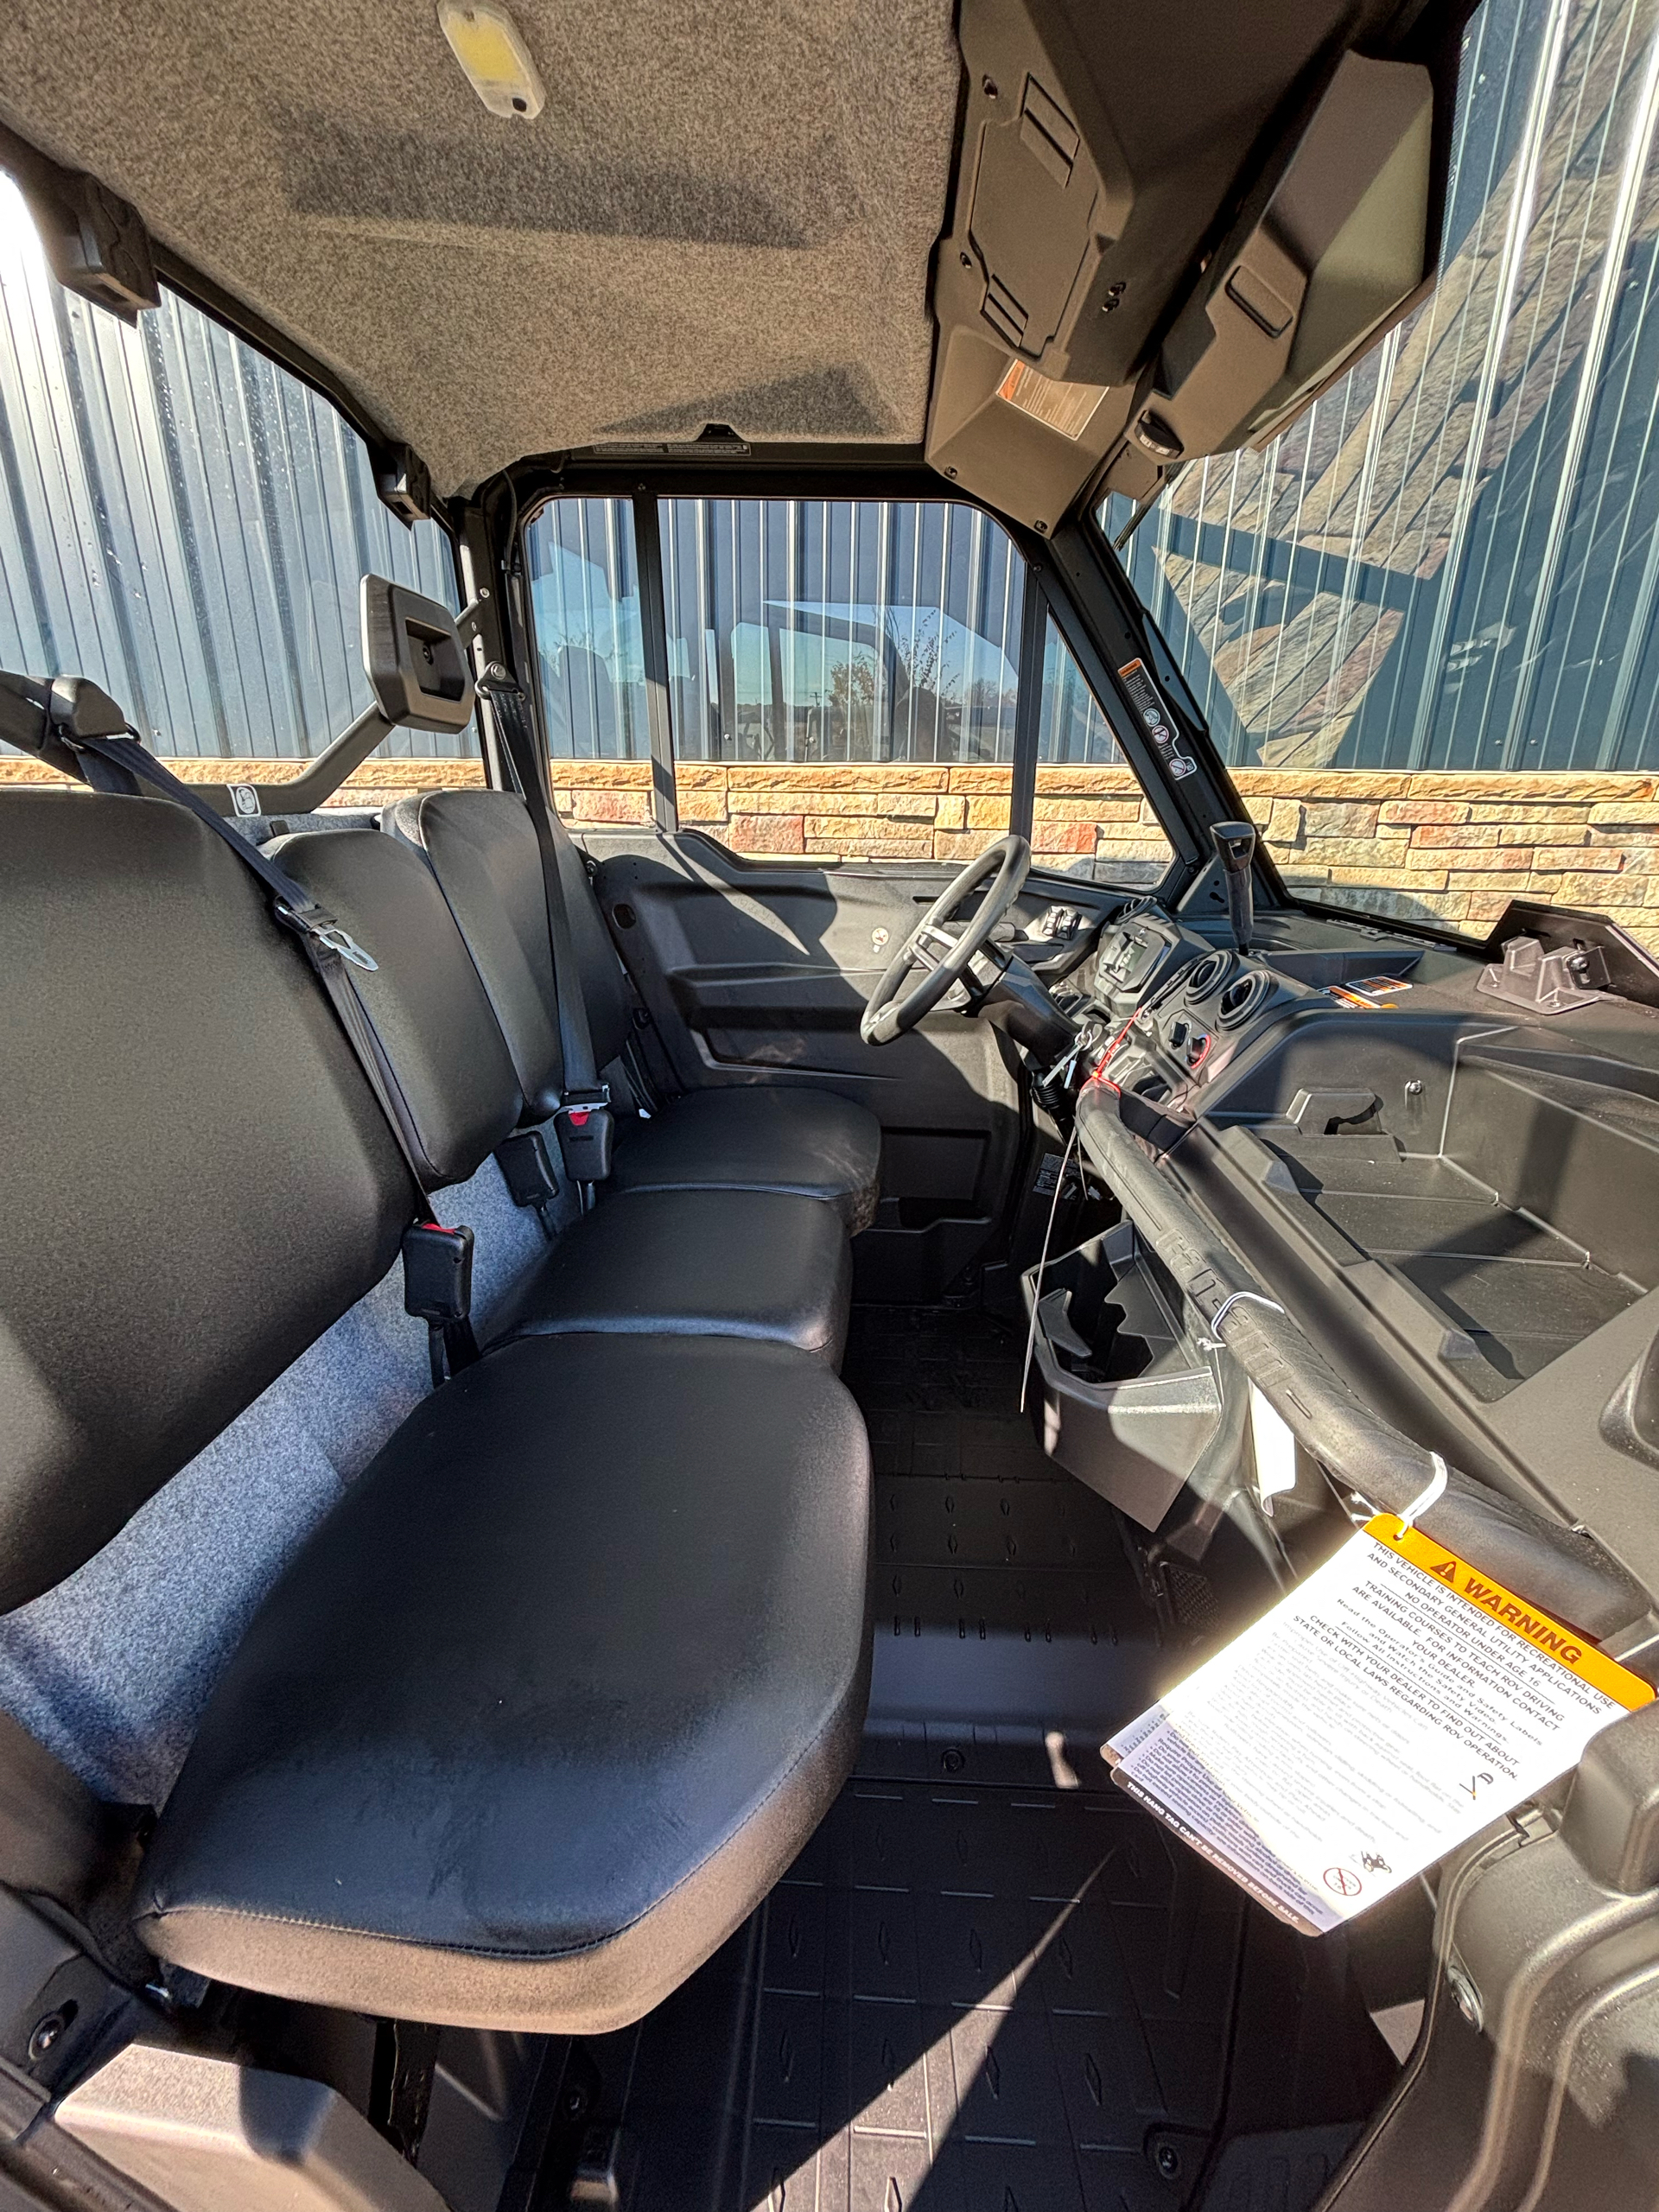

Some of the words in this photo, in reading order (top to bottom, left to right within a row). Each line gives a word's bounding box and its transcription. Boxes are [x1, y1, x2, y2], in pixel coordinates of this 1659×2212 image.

[1309, 1614, 1339, 1638] CHECK
[1339, 1637, 1364, 1656] WITH
[1364, 1654, 1390, 1675] YOUR
[1389, 1672, 1427, 1700] DEALER
[1427, 1698, 1440, 1710] TO
[1440, 1708, 1464, 1726] FIND
[1462, 1726, 1485, 1741] OUT
[1484, 1741, 1519, 1765] ABOUT
[1336, 1598, 1360, 1617] Read
[1360, 1616, 1376, 1628] the
[1427, 1662, 1455, 1683] Guide
[1455, 1683, 1476, 1698] and
[1476, 1697, 1508, 1721] Safety
[1509, 1720, 1542, 1745] Labels
[1340, 1620, 1370, 1643] Follow
[1371, 1643, 1386, 1654] All
[1385, 1653, 1440, 1694] Instructions
[1442, 1694, 1462, 1708] and
[1463, 1707, 1507, 1741] Warnings.
[1351, 1586, 1371, 1600] ARE
[1425, 1637, 1446, 1653] FOR
[1446, 1650, 1512, 1698] INFORMATION
[1511, 1696, 1560, 1731] CONTACT
[1364, 1580, 1408, 1613] TRAINING
[1408, 1611, 1452, 1643] COURSES
[1452, 1642, 1467, 1653] TO
[1468, 1652, 1501, 1676] TEACH
[1499, 1675, 1522, 1691] ROV
[1522, 1690, 1565, 1721] DRIVING
[1366, 1552, 1388, 1568] AND
[1387, 1567, 1444, 1605] SECONDARY
[1443, 1605, 1487, 1637] GENERAL
[1489, 1636, 1529, 1663] UTILITY
[1529, 1663, 1601, 1714] APPLICATIONS
[1368, 1631, 1387, 1645] and
[1387, 1643, 1416, 1667] Watch
[1417, 1665, 1433, 1678] the
[1434, 1678, 1465, 1701] Safety
[1468, 1700, 1496, 1723] Video.
[1373, 1541, 1395, 1560] THIS
[1395, 1557, 1434, 1586] VEHICLE
[1433, 1585, 1446, 1594] IS
[1446, 1592, 1495, 1626] INTENDED
[1494, 1625, 1516, 1642] FOR
[1516, 1640, 1590, 1694] RECREATIONAL
[1592, 1692, 1616, 1709] USE
[1403, 1591, 1421, 1604] NO
[1420, 1602, 1471, 1638] OPERATOR
[1470, 1637, 1505, 1662] UNDER
[1504, 1661, 1528, 1677] AGE
[1528, 1676, 1541, 1687] 16
[1411, 1639, 1438, 1660] YOUR
[1436, 1658, 1475, 1688] DEALER.
[1464, 1578, 1581, 1663] WARNING
[1292, 1614, 1320, 1636] STATE
[1319, 1634, 1334, 1646] OR
[1333, 1644, 1361, 1668] LOCAL
[1362, 1666, 1389, 1687] LAWS
[1389, 1685, 1442, 1726] REGARDING
[1441, 1724, 1464, 1739] ROV
[1463, 1738, 1517, 1779] OPERATION.
[1126, 1781, 1145, 1798] THIS
[1142, 1795, 1166, 1815] HANG
[1164, 1812, 1180, 1827] TAG
[1201, 1843, 1214, 1854] BE
[1211, 1853, 1249, 1883] REMOVED
[1247, 1880, 1279, 1906] BEFORE
[1276, 1904, 1299, 1924] SALE.
